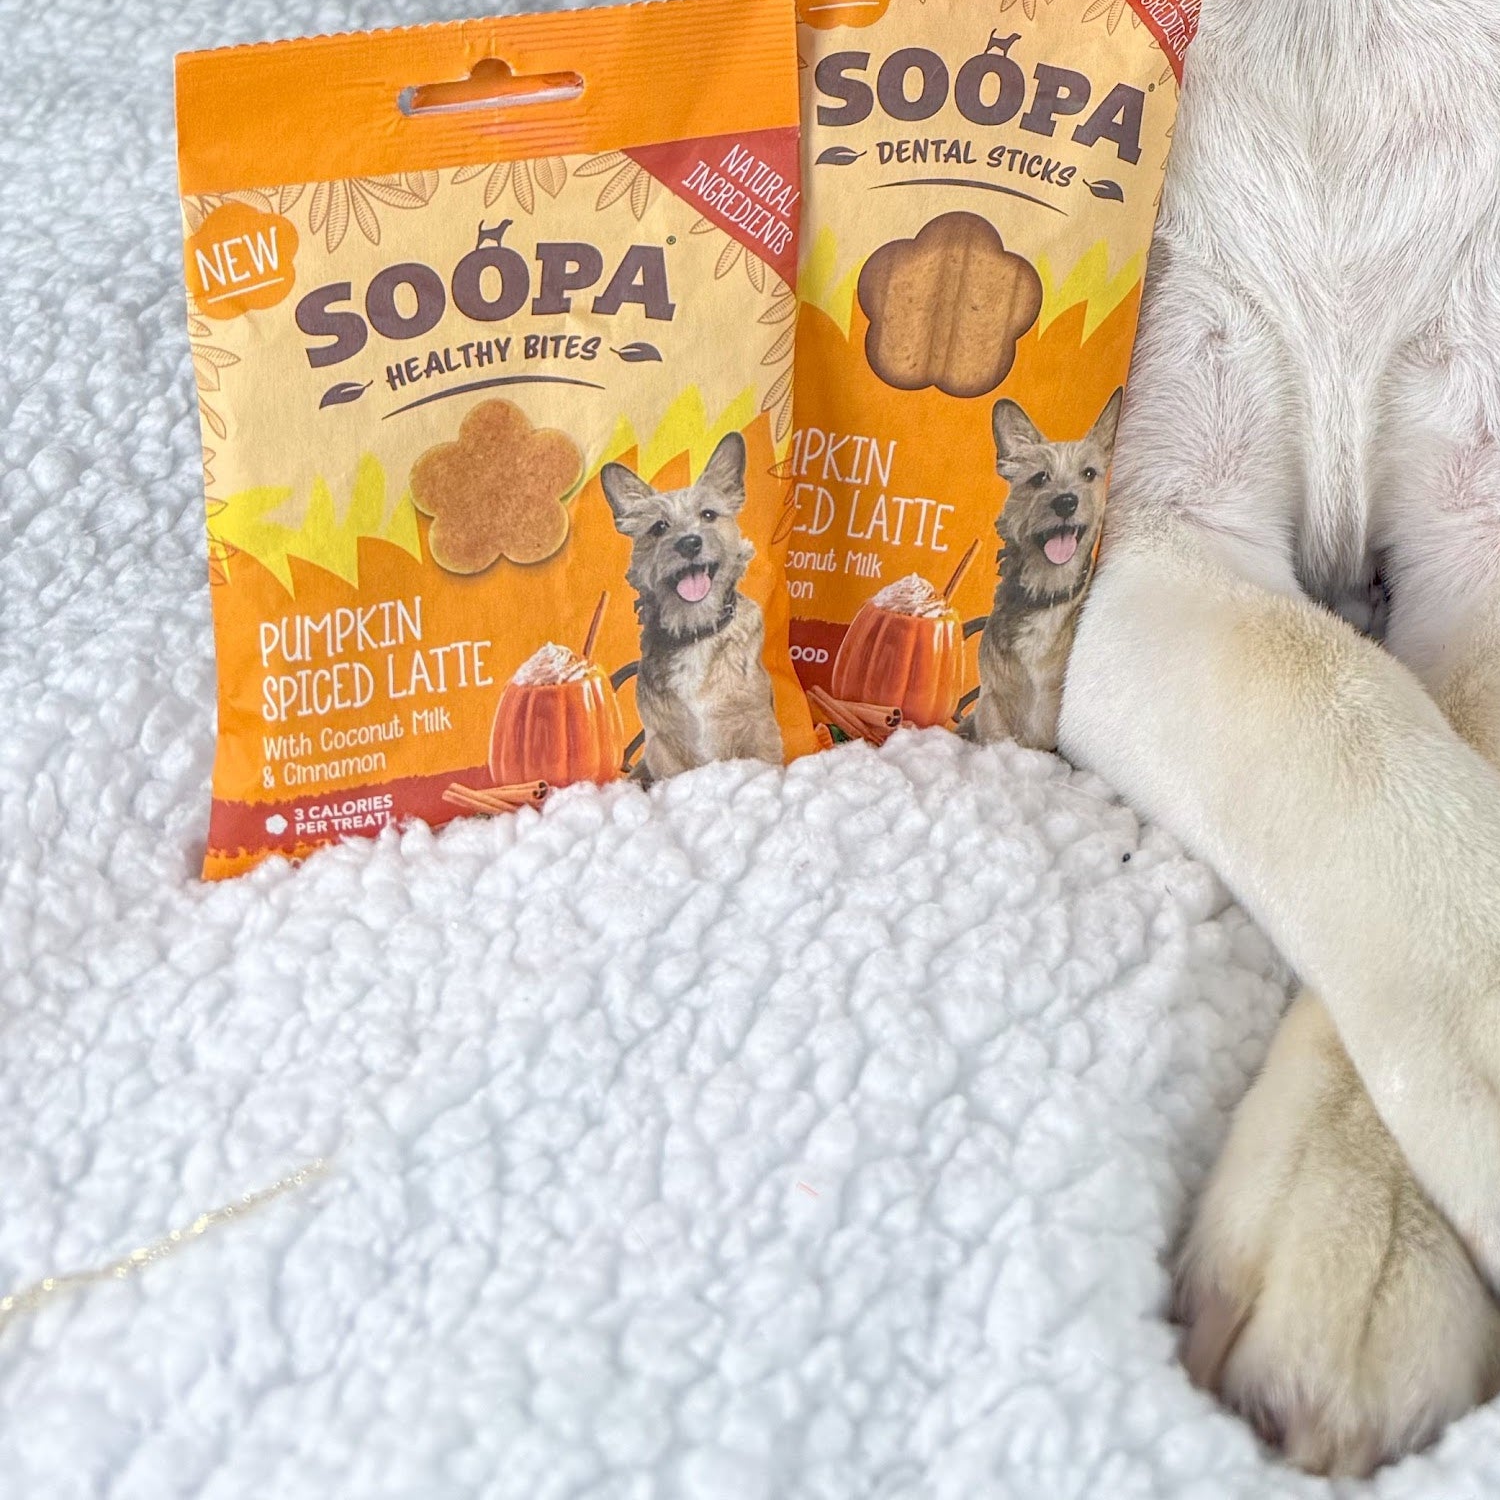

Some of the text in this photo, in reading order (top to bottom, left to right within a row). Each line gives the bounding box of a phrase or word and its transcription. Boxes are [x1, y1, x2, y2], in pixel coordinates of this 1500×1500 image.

[719, 143, 800, 218] NATURAL
[876, 139, 1077, 187] DENTAL STICKS
[681, 160, 793, 255] INGREDIENTS
[196, 226, 280, 291] NEW
[386, 334, 602, 391] HEALTHY BITES
[792, 427, 897, 487] PKIN
[847, 490, 955, 552] LATTE
[844, 550, 883, 579] Milk
[259, 595, 423, 668] PUMPKIN
[262, 640, 494, 722] SPICED LATTE
[262, 707, 453, 762] With Coconut Milk
[262, 752, 387, 789] & Cinnamon
[294, 793, 394, 821] 3 CALORIES
[295, 820, 328, 836] PER
